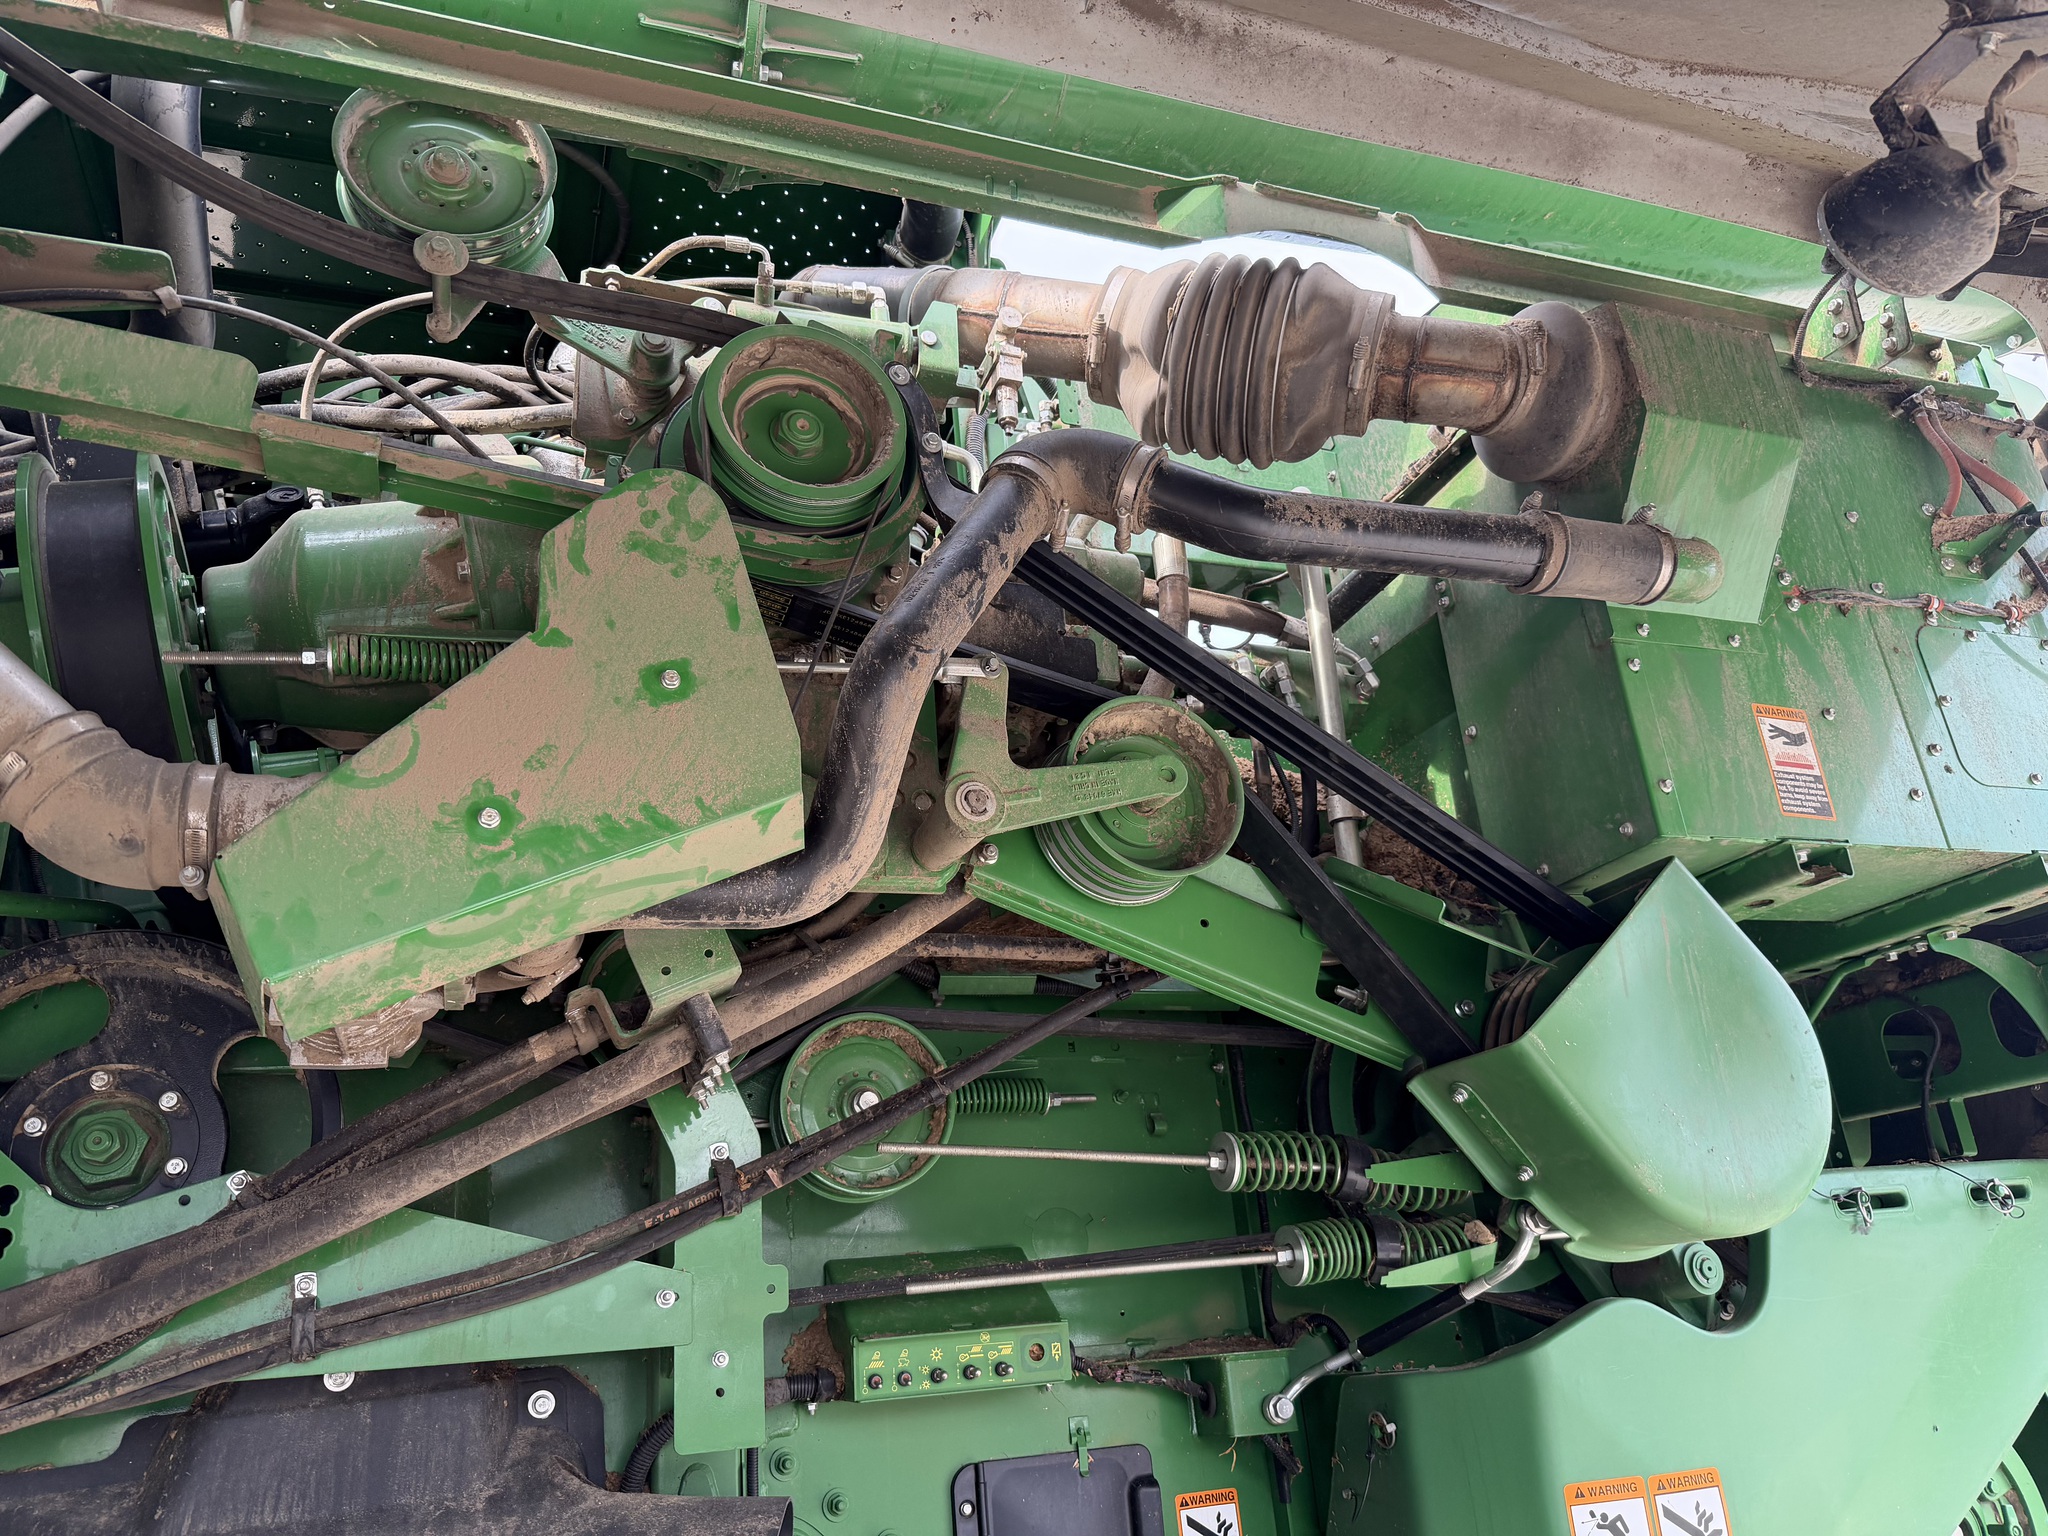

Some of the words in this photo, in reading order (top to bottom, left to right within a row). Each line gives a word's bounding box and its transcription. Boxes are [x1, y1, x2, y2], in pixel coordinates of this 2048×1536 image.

[1762, 706, 1805, 720] WARNING
[1774, 771, 1795, 779] Exhaust
[1776, 779, 1805, 787] components
[1783, 805, 1816, 813] components.
[431, 1288, 452, 1300] BAR
[1667, 1472, 1715, 1489] WARNING
[1588, 1482, 1638, 1497] WARNING
[1189, 1491, 1235, 1505] WARNING
